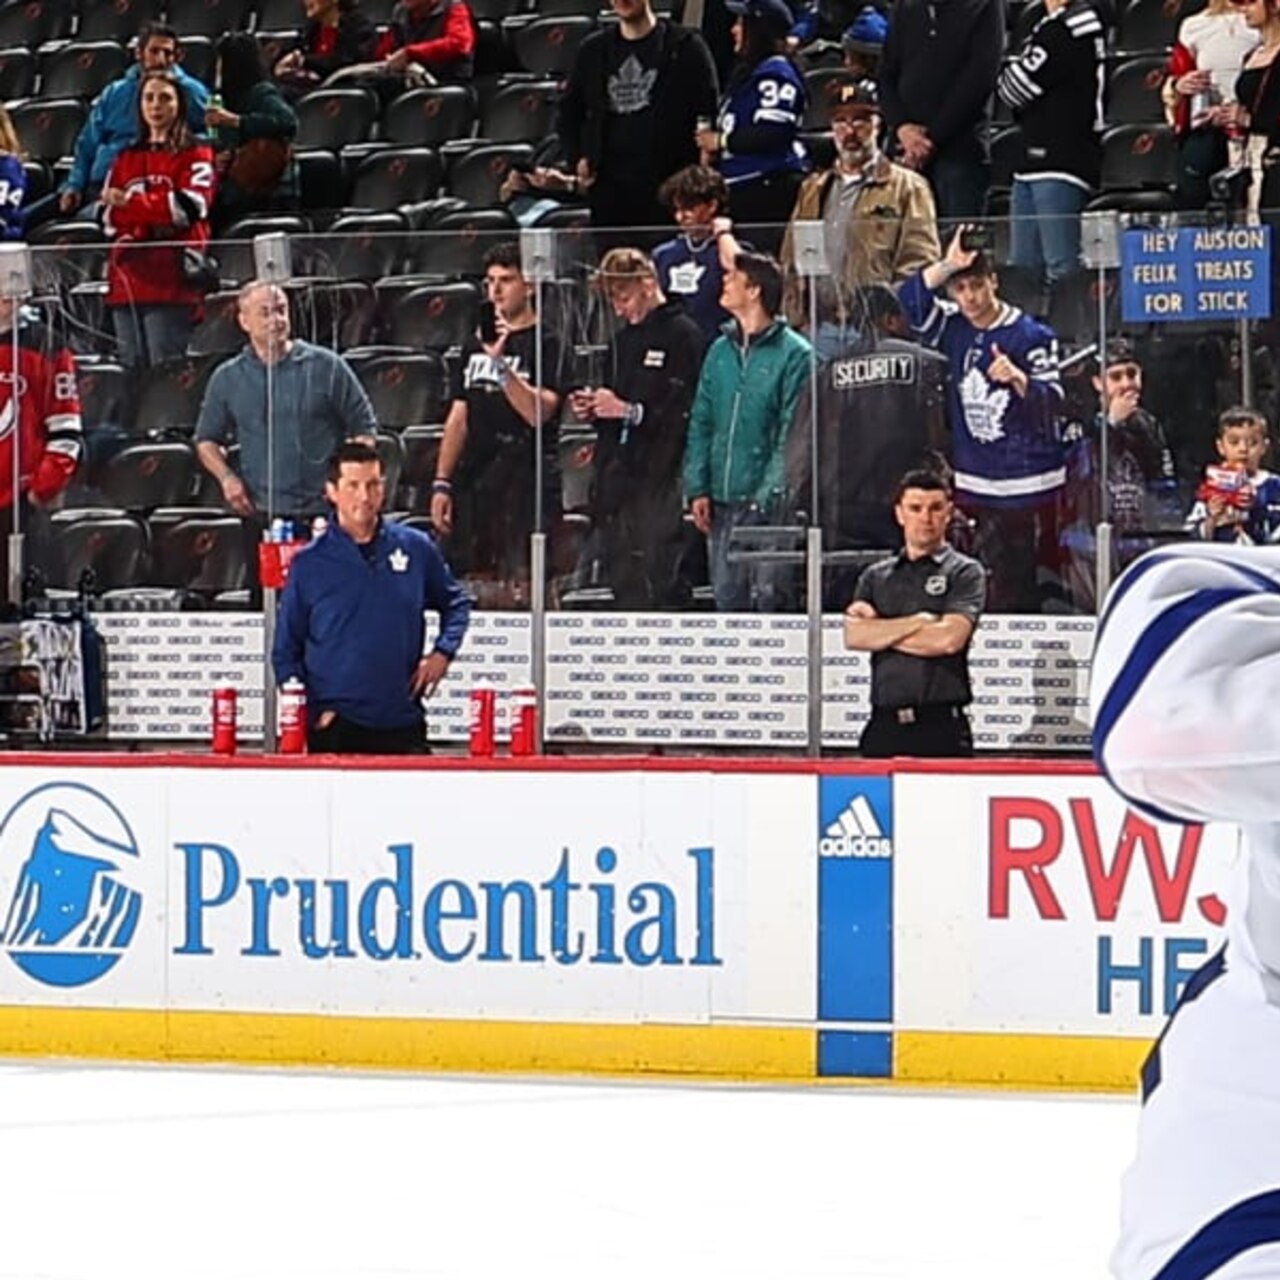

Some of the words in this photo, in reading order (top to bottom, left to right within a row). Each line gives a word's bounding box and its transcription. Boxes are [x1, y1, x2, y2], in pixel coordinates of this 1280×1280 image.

[1143, 233, 1179, 253] HEY
[1194, 229, 1264, 250] AUSTON
[1133, 263, 1177, 283] FELIX
[1194, 260, 1254, 280] TREATS
[1144, 293, 1182, 313] FOR
[1198, 290, 1248, 311] STICK
[836, 355, 908, 386] SECURITY
[819, 833, 892, 859] adidas
[988, 797, 1227, 926] RW
[173, 843, 723, 967] Prudential
